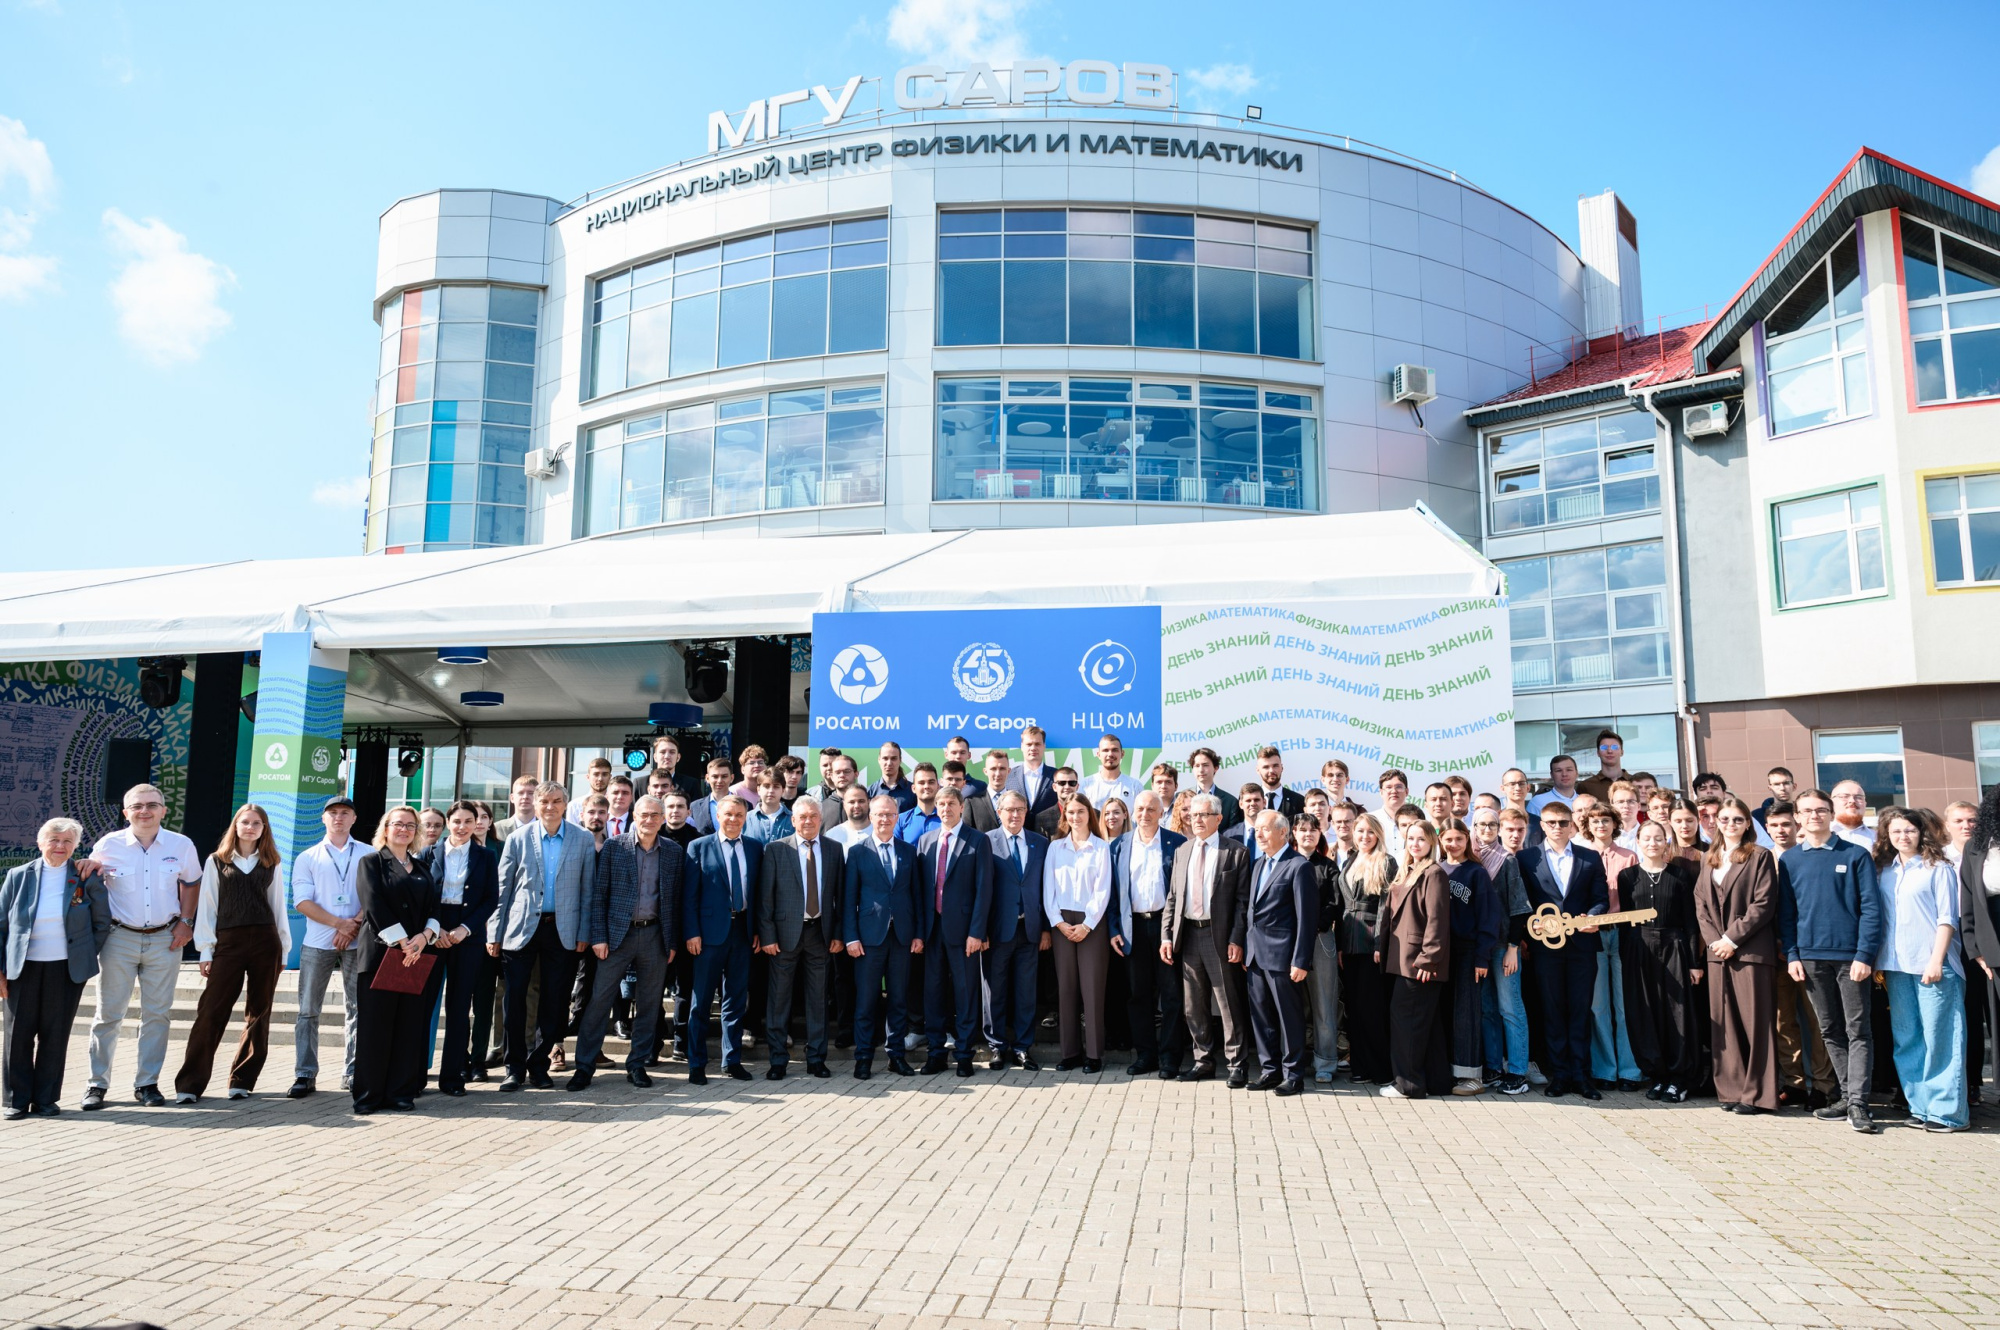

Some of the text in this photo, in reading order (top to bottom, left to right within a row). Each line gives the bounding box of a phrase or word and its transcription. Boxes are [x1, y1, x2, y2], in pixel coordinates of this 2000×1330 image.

[708, 59, 1173, 153] МГУ САРОВ
[585, 133, 1303, 232] НАЦИОНАЛЬНЫЙ ЦЕНТР ФИЗИКИ И МАТЕМАТИКИ
[1167, 626, 1494, 670] ДЕНЬ ЗНАНИЙ ДЕНЬ ЗНАНИЙ ДЕНЬ ЗНАНИЙ
[1164, 665, 1492, 706] ДЕНЬ ЗНАНИЙ ДЕНЬ ЗНАНИЙ ДЕНЬ ЗНАНИЙ
[815, 716, 900, 730] РОСАТОМ
[927, 714, 1037, 733] МГУ Саров
[1072, 711, 1145, 732] НЦФМ
[71, 715, 104, 775] МАТЕМАТИКА
[1315, 737, 1381, 761] ЗНАНИЙ
[1381, 753, 1424, 772] ДЕНЬ
[1428, 750, 1494, 773] ЗНАНИЙ
[258, 773, 291, 781] РОСАТОМ
[301, 775, 336, 785] МГУ Саров
